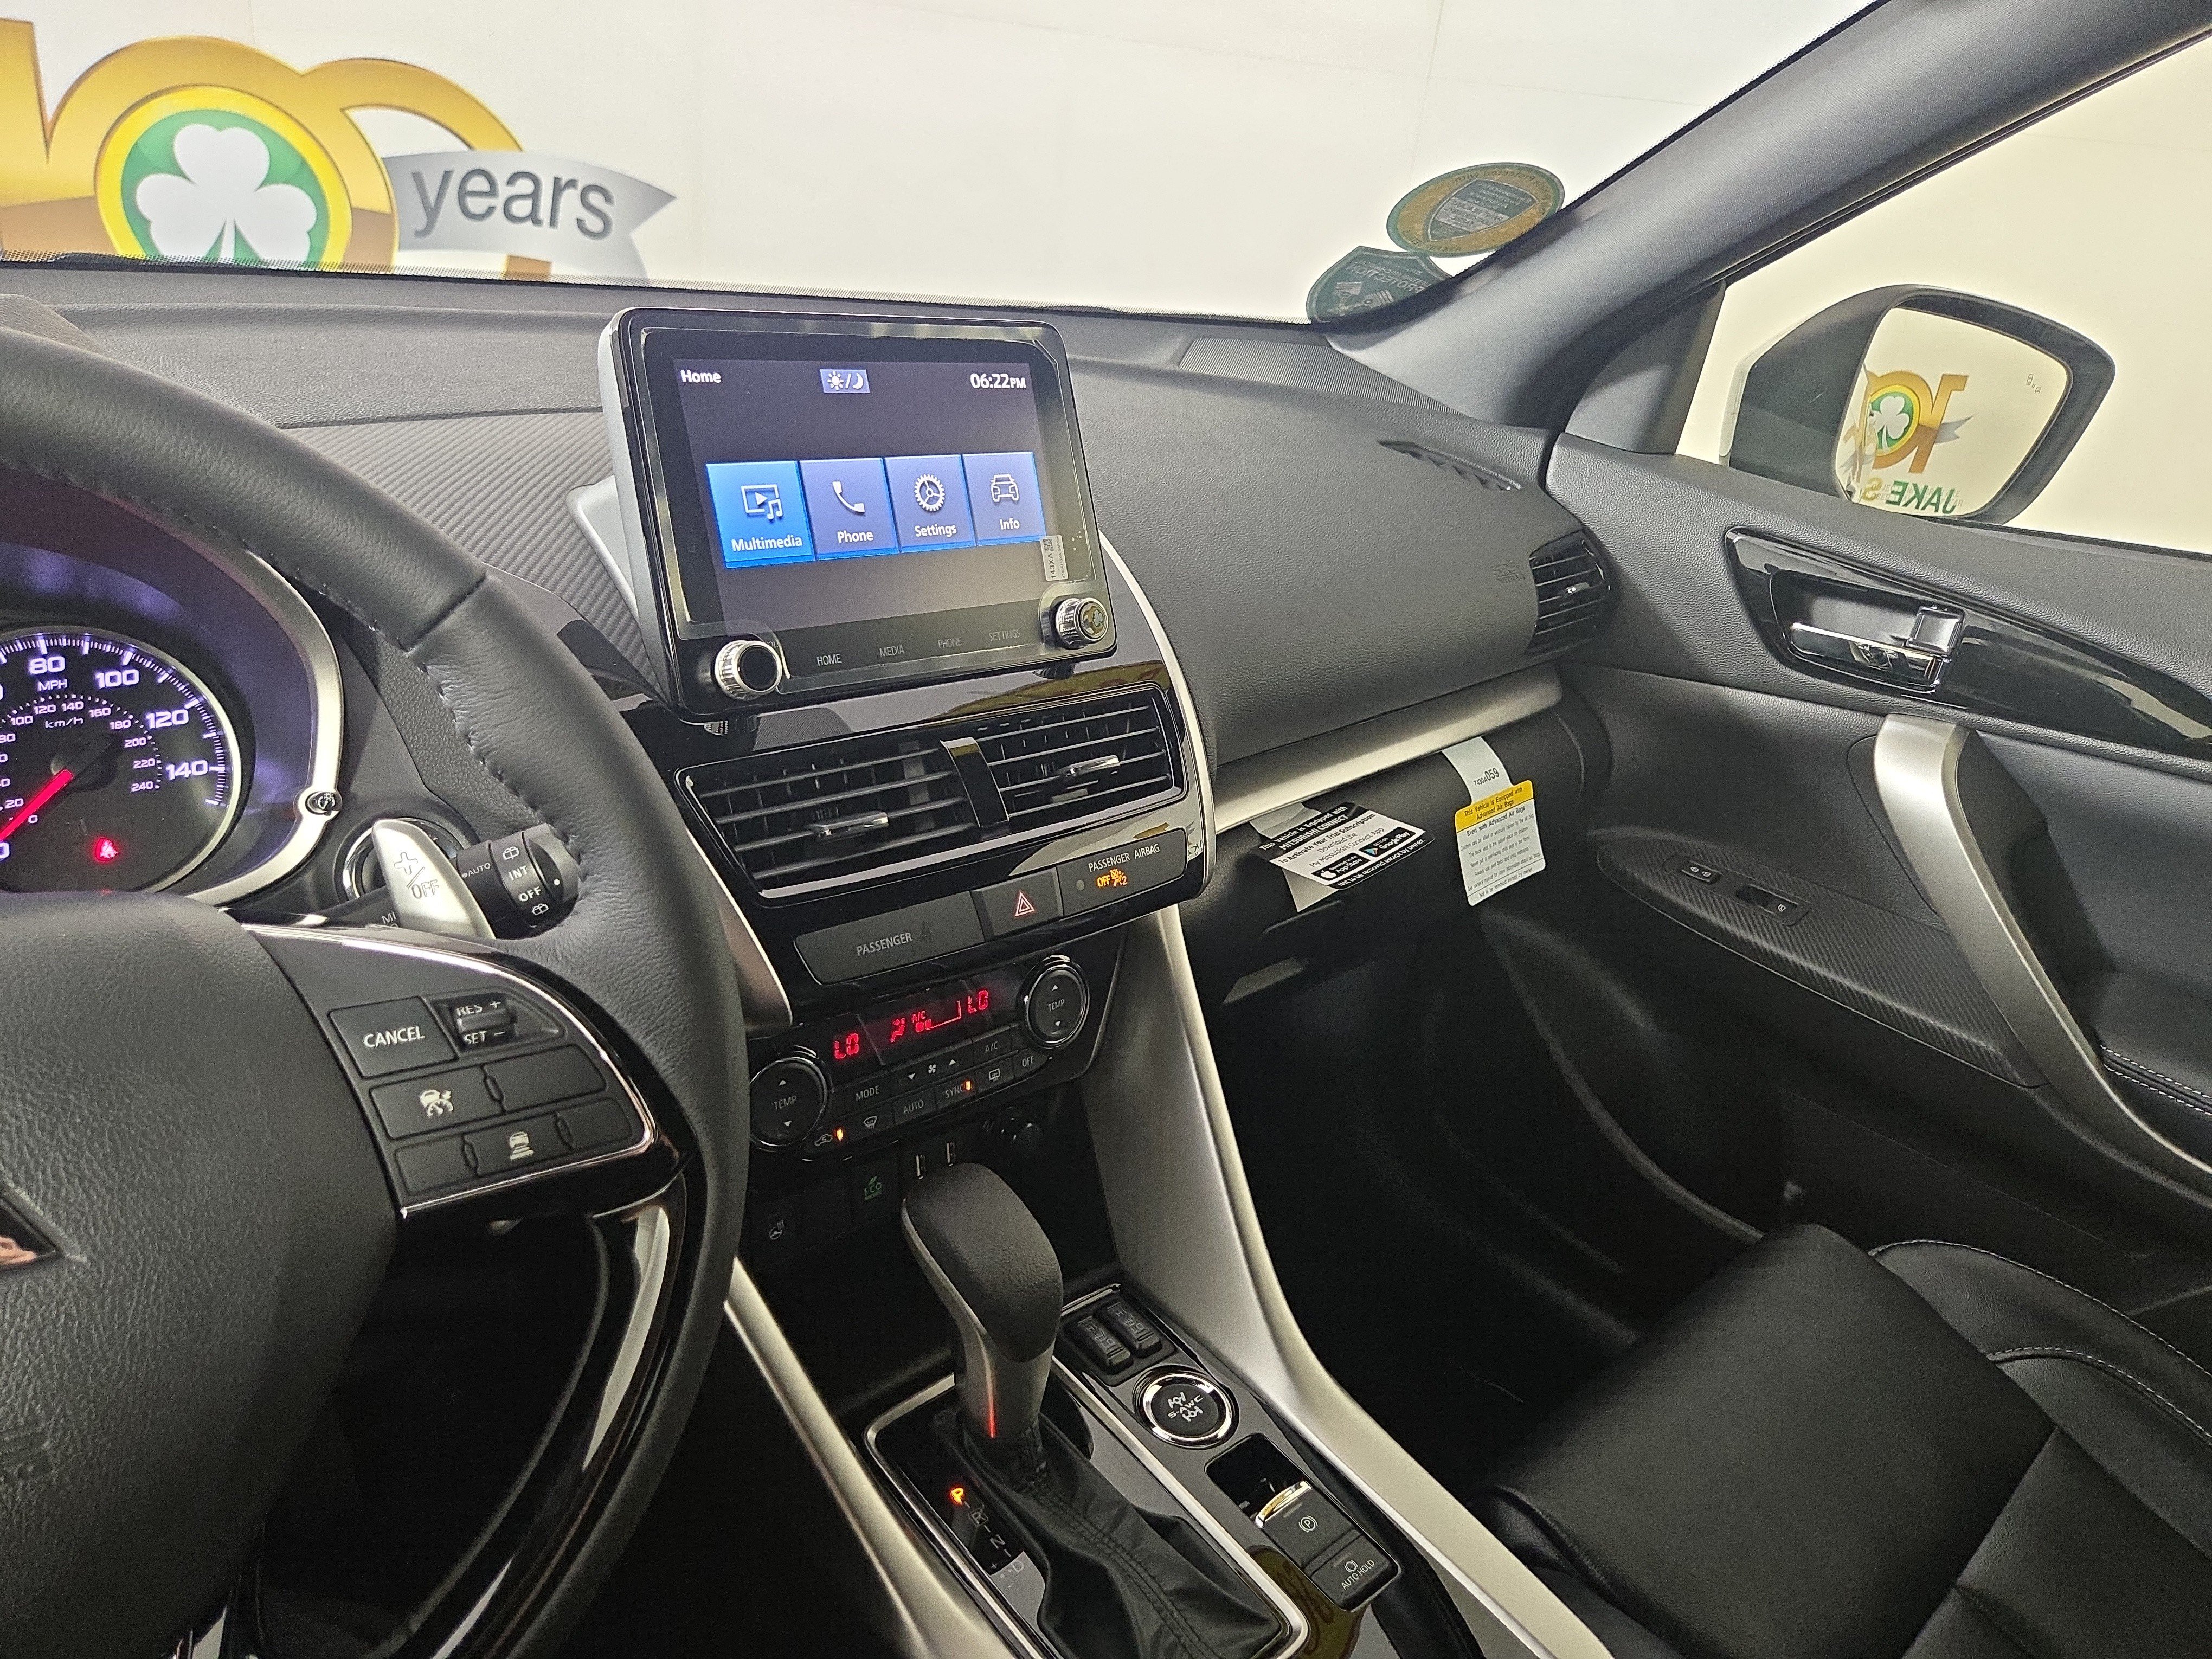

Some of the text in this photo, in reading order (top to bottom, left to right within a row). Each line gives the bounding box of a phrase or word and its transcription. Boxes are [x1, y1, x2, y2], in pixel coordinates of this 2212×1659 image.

[411, 165, 613, 241] years
[681, 369, 722, 384] Home
[915, 522, 956, 538] Settings
[999, 517, 1020, 531] Info
[731, 533, 803, 552] Multimedia
[837, 528, 873, 544] Phone
[1048, 553, 1056, 578] 143XA
[938, 636, 963, 648] PHONE
[989, 629, 1020, 641] SETTINGS
[880, 645, 905, 657] MEDIA
[29, 655, 65, 674] 80
[817, 654, 842, 666] HOME
[38, 679, 68, 691] MPH
[95, 669, 139, 689] 100
[34, 704, 56, 715] 120
[61, 701, 84, 711] 140
[89, 708, 111, 717] 160
[11, 716, 33, 726] 100
[45, 717, 83, 729] km/h
[110, 719, 132, 729] 180
[146, 710, 189, 729] 120
[124, 737, 146, 748] 200
[133, 758, 155, 769] 220
[166, 760, 208, 779] 140
[132, 781, 153, 792] 240
[5, 798, 24, 809] 20
[1474, 802, 1489, 812] Vehicle
[1495, 790, 1514, 805] Equipped
[1476, 808, 1496, 820] Advanced
[1504, 800, 1514, 808] Bags
[28, 815, 38, 824] 0
[1467, 828, 1477, 837] Even
[1489, 814, 1507, 827] Advanced
[1516, 806, 1525, 814] Bags
[1259, 842, 1275, 850] This
[1274, 830, 1298, 843] Vehicle
[1304, 813, 1333, 827] Equipped
[1332, 806, 1348, 814] with
[1278, 814, 1348, 850] MITSUBISHI CONNECT
[1288, 844, 1314, 860] Activate
[1311, 837, 1328, 846] Your
[1325, 831, 1341, 839] Trial
[1338, 814, 1375, 833] Subscription
[1317, 837, 1348, 853] Download
[1379, 836, 1398, 849] Google
[1319, 845, 1351, 863] Mitsubishi
[1348, 834, 1373, 847] Connect
[1371, 828, 1384, 836] App
[1088, 844, 1160, 872] PASSENGER AIRBAG
[1346, 858, 1363, 867] Store
[1362, 861, 1386, 876] removed
[1384, 851, 1401, 863] except
[1407, 839, 1426, 850] owner.
[468, 863, 491, 877] AUTO
[509, 865, 529, 881] INT
[411, 879, 439, 899] OFF
[1097, 874, 1110, 888] OFF
[518, 886, 542, 902] OFF
[382, 911, 397, 924] MI
[856, 931, 912, 956] PASSENGER
[456, 1002, 483, 1017] RES
[968, 989, 988, 1014] LO
[1047, 998, 1065, 1011] TEMP
[363, 1025, 425, 1049] CANCEL
[464, 1030, 487, 1045] SET
[835, 1032, 859, 1060] LO
[985, 1041, 998, 1053] A/C
[1021, 1054, 1035, 1067] OFF
[856, 1085, 879, 1101] MODE
[945, 1084, 966, 1098] SYNC
[774, 1094, 798, 1110] TEMP
[903, 1098, 924, 1115] AUTO
[1168, 1394, 1204, 1419] S-AWC
[951, 1487, 964, 1504] P
[990, 1534, 1006, 1549] N
[1012, 1560, 1024, 1573] D
[1341, 1559, 1375, 1590] AUTO HOLD
